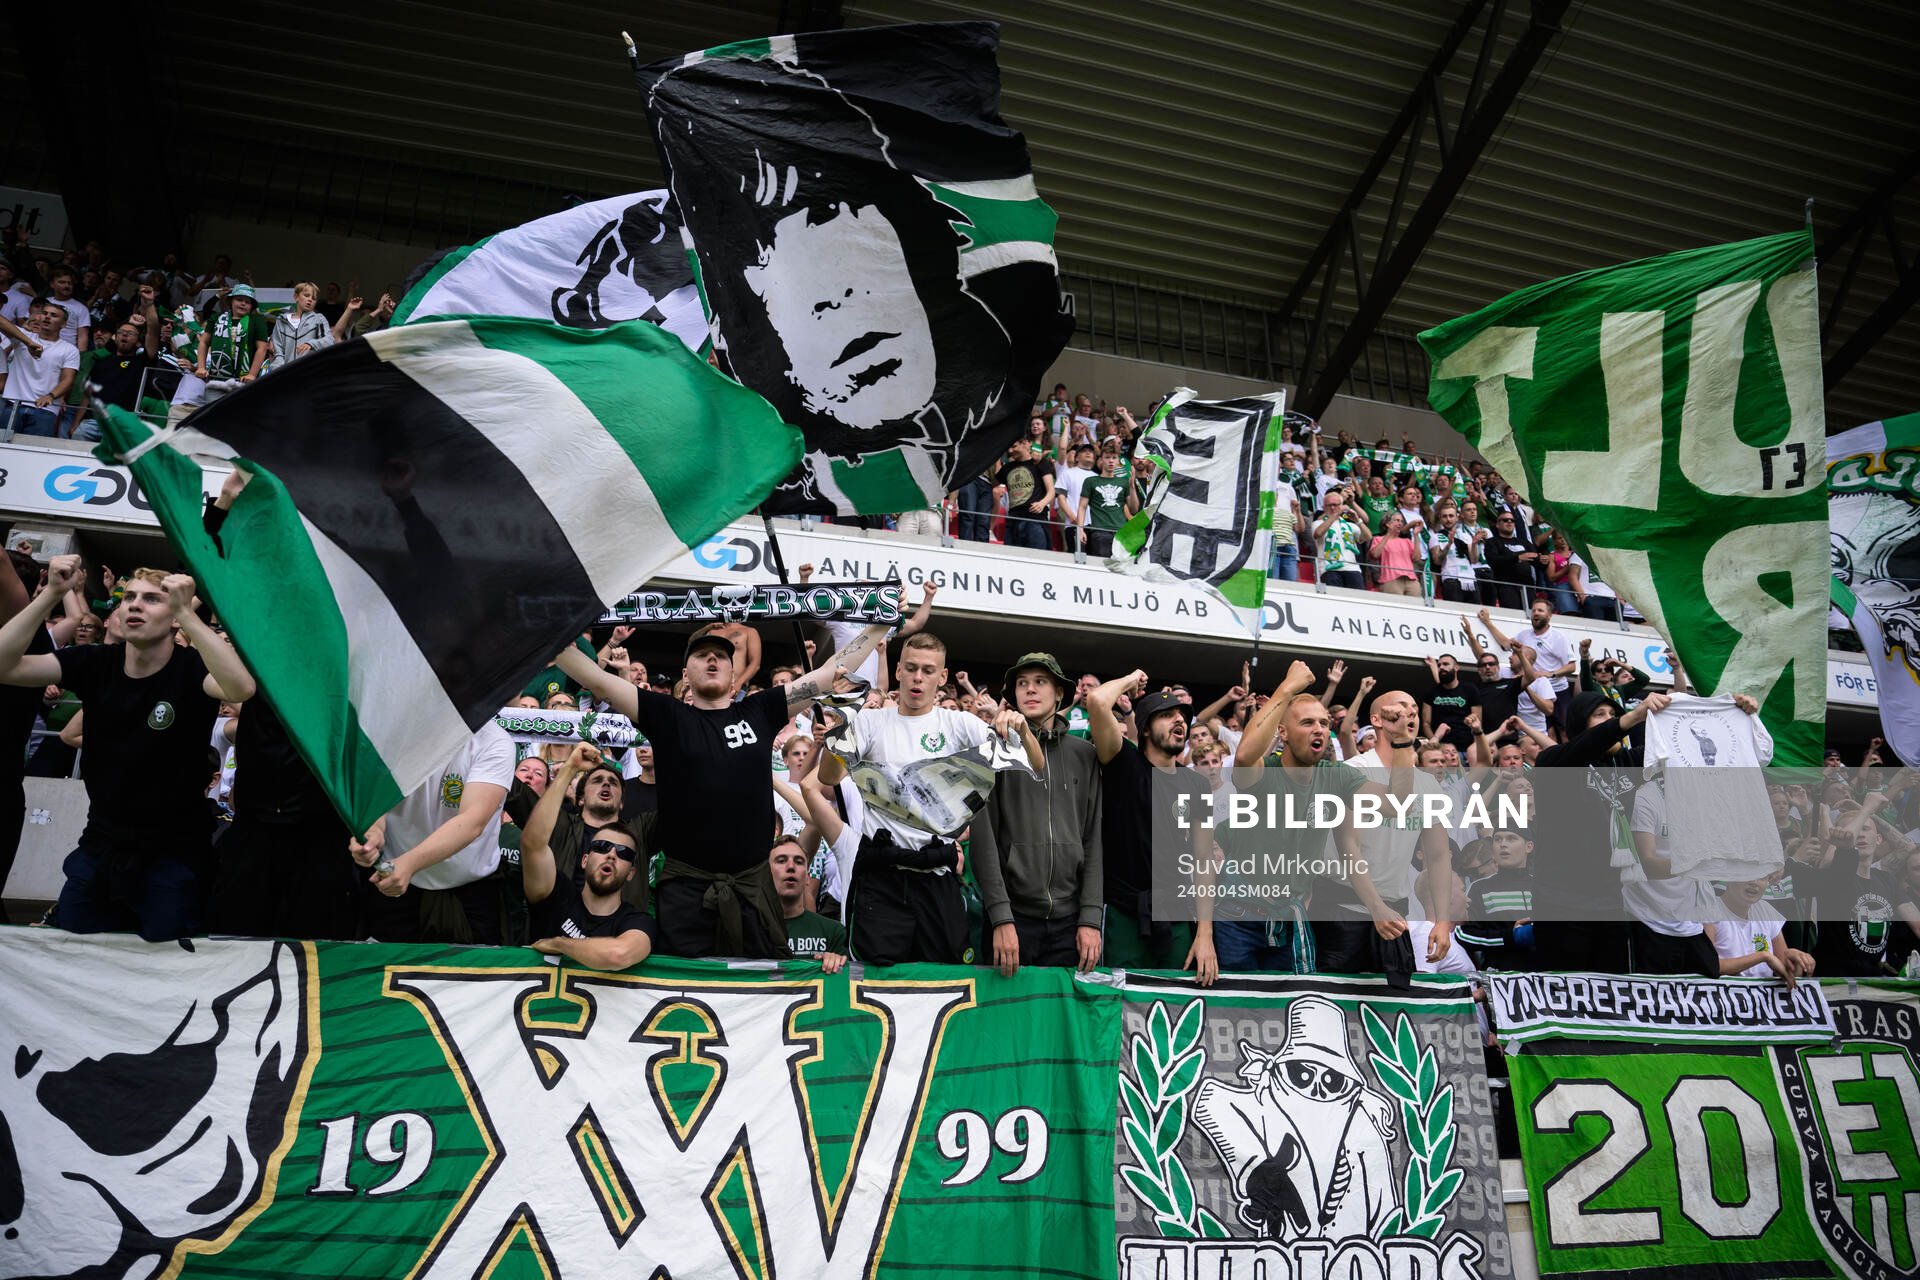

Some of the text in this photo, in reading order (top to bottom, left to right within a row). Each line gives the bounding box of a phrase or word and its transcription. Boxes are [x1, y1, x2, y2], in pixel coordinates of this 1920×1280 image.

[760, 584, 902, 621] BOYS
[818, 557, 1209, 617] ANLÄGGNING & MILJÖ AB
[1331, 615, 1489, 649] ANLÄGGNING
[1835, 672, 1865, 690] FÖR
[495, 716, 574, 736] orever
[724, 720, 757, 748] 99
[501, 847, 520, 861] OYS
[797, 938, 827, 951] BOYS
[1494, 976, 1821, 1025] YNGREFRAKTIONEN
[1831, 1004, 1912, 1040] TRAS
[1784, 1063, 1820, 1161] CURVA
[305, 1109, 437, 1197] 19
[935, 1106, 1049, 1188] 99
[1530, 1075, 1783, 1248] 20
